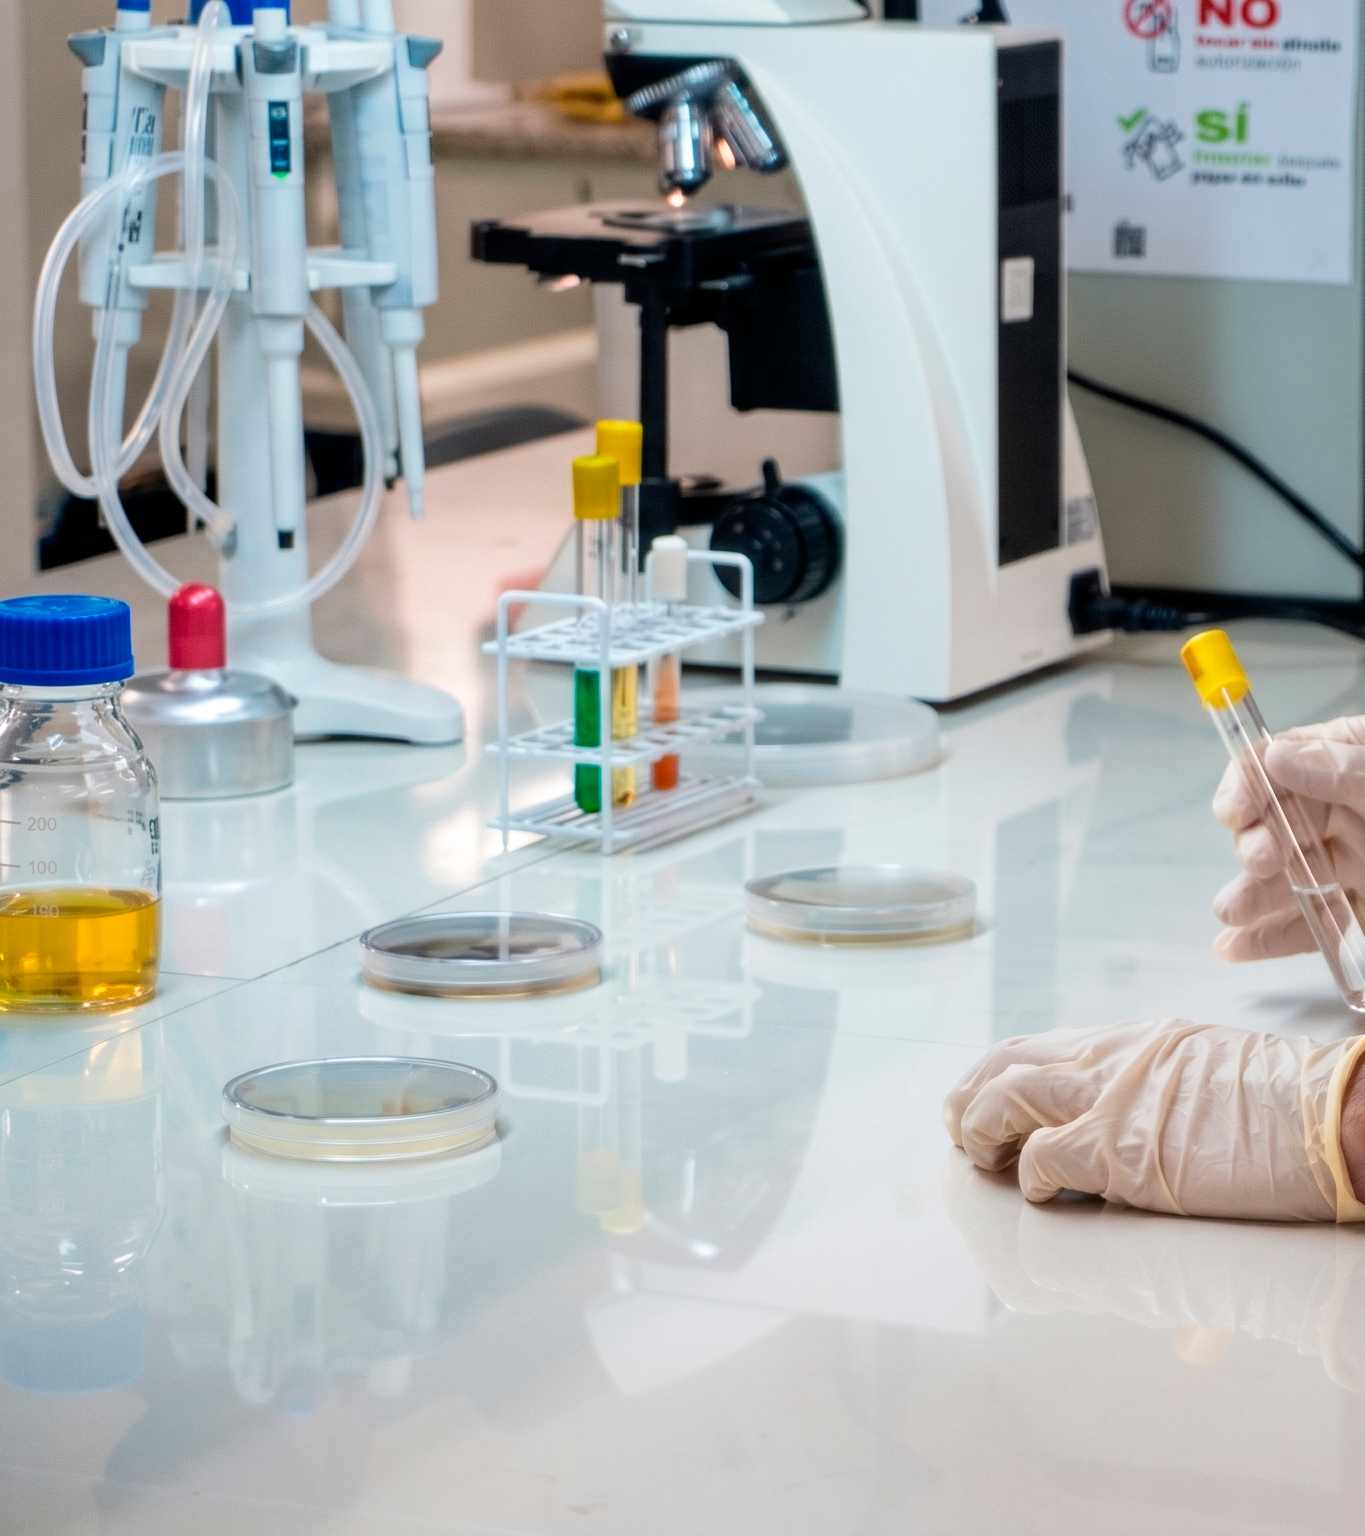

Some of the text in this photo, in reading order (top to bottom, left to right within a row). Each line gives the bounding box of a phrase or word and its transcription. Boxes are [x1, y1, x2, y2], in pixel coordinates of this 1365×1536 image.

[1198, 0, 1279, 29] NO
[27, 816, 57, 832] 200
[29, 860, 58, 875] 100
